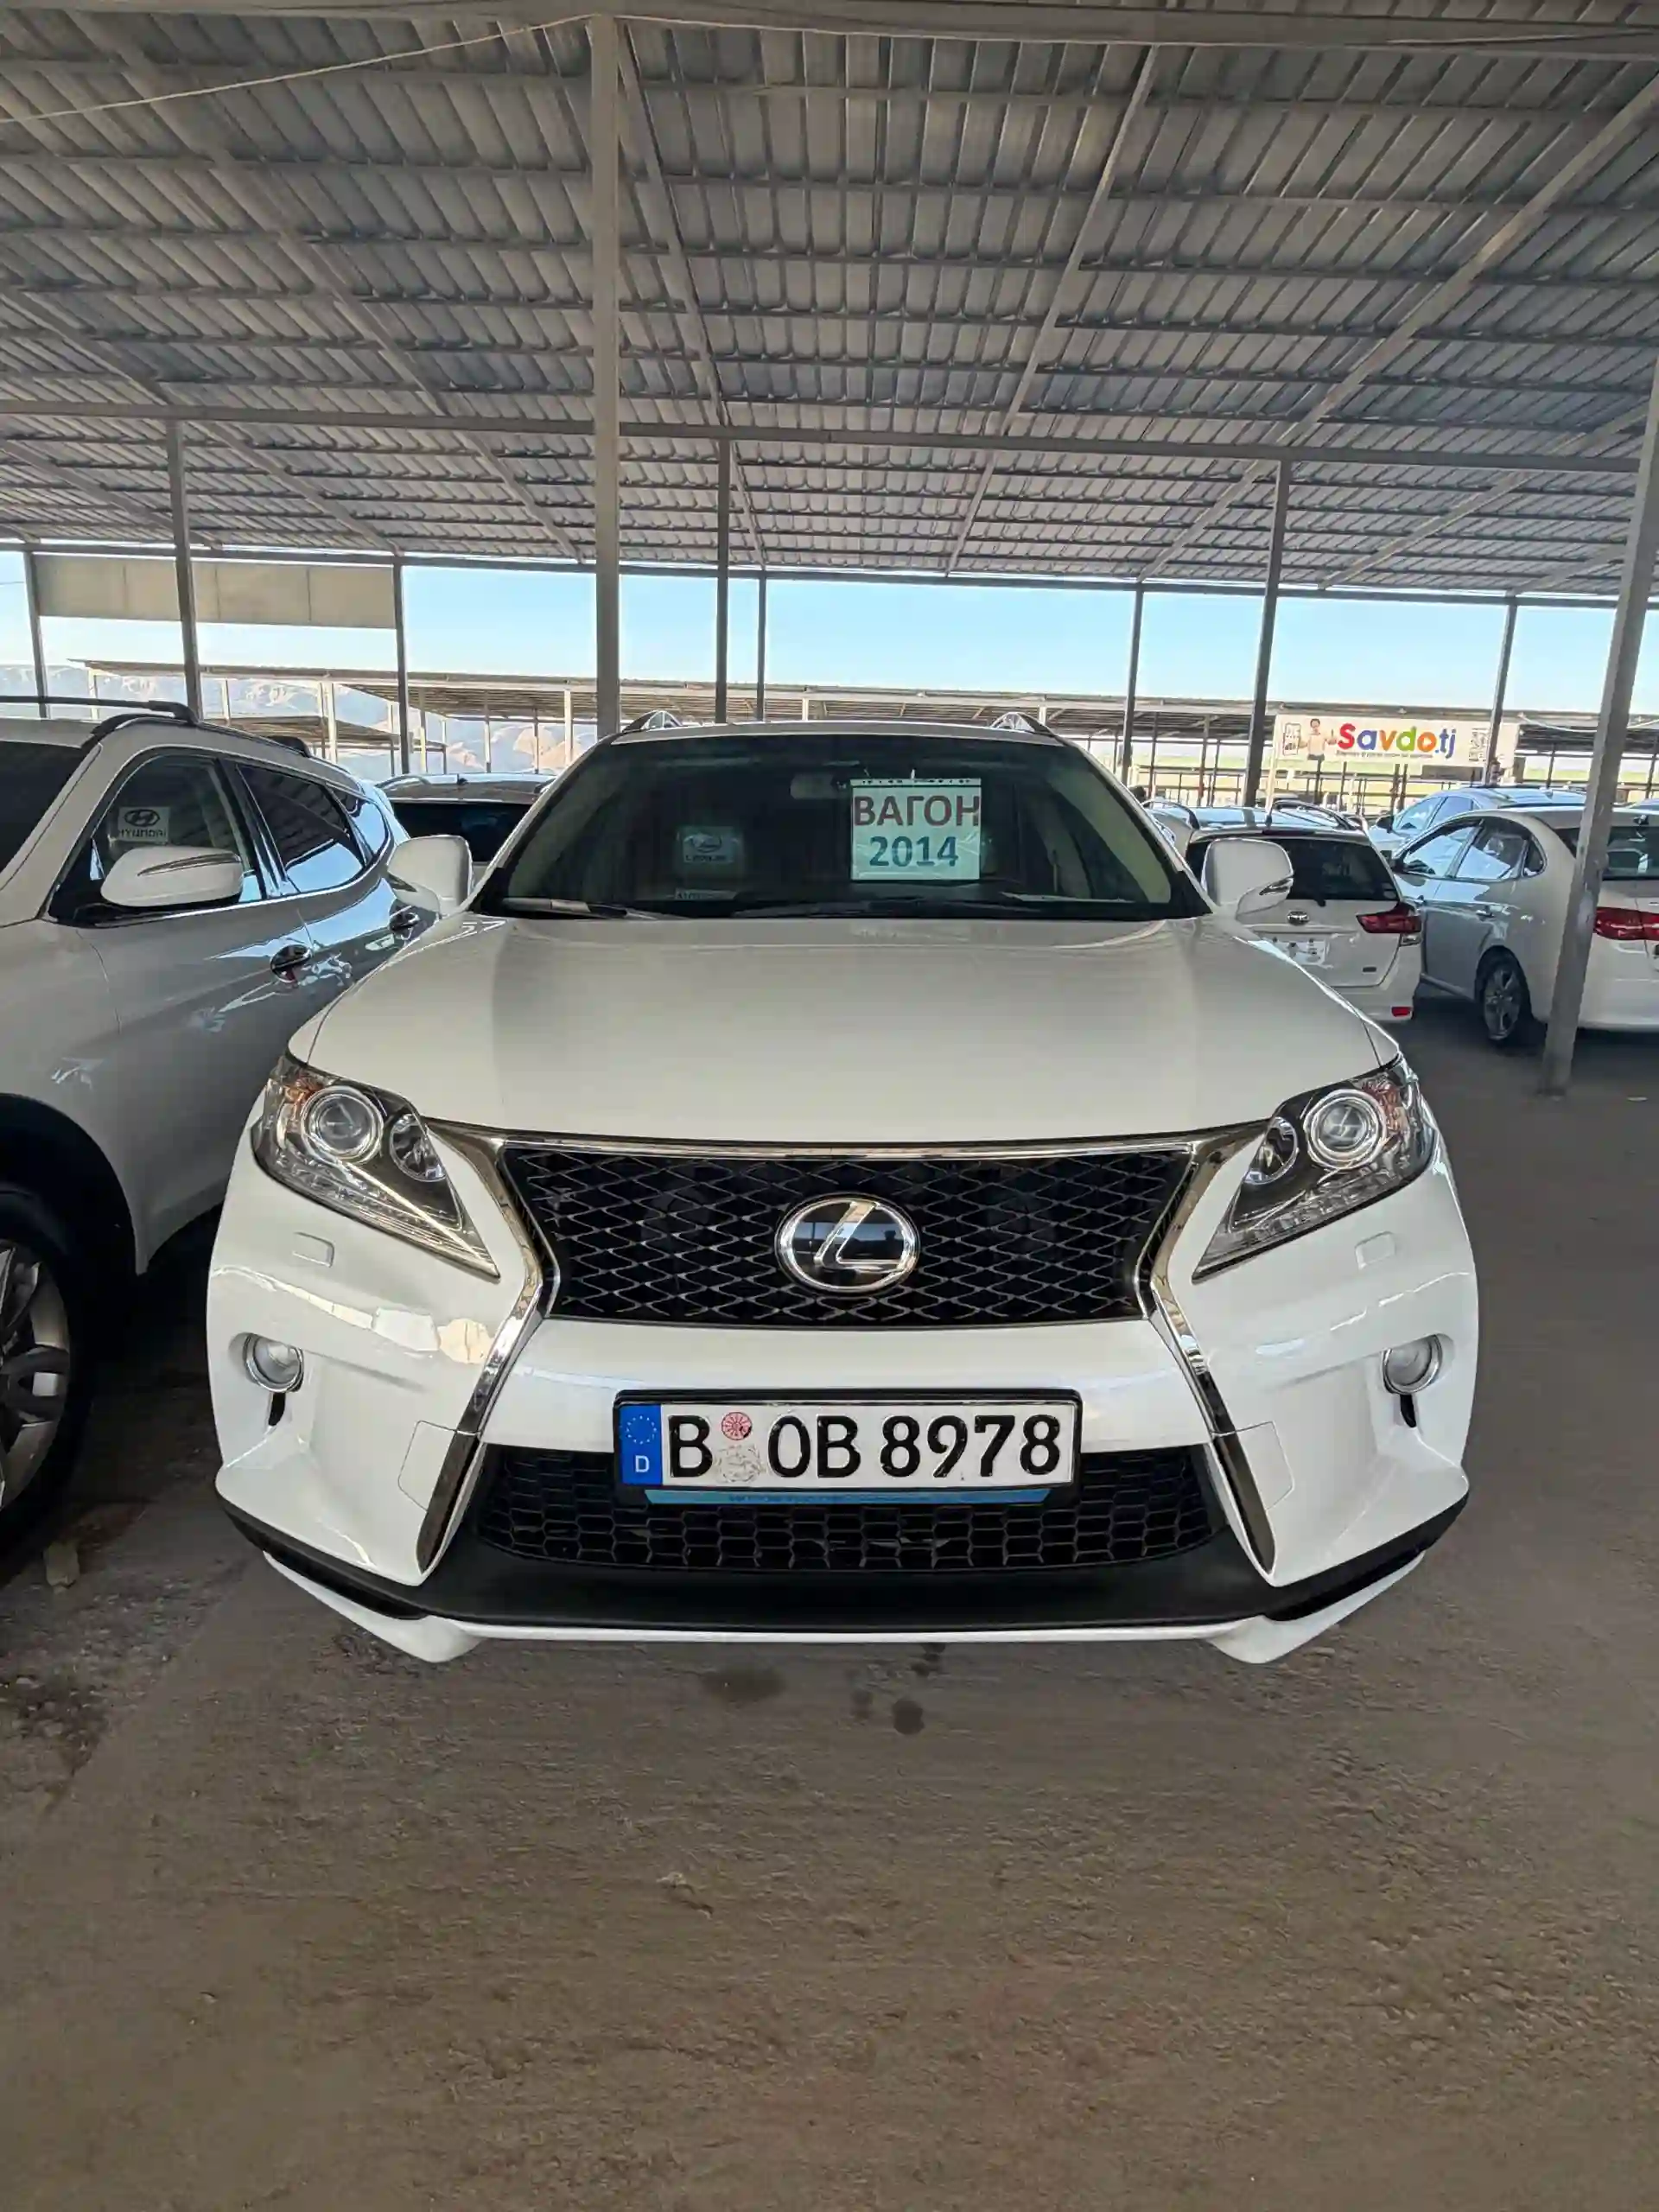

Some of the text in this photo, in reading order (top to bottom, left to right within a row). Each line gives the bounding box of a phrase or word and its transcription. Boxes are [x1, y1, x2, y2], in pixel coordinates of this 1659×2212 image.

[1337, 722, 1457, 759] Savdo.tj
[854, 795, 981, 826] ВАГОН
[869, 836, 959, 868] 2014
[668, 1414, 1061, 1479] B OB 8978
[635, 1455, 650, 1473] D
